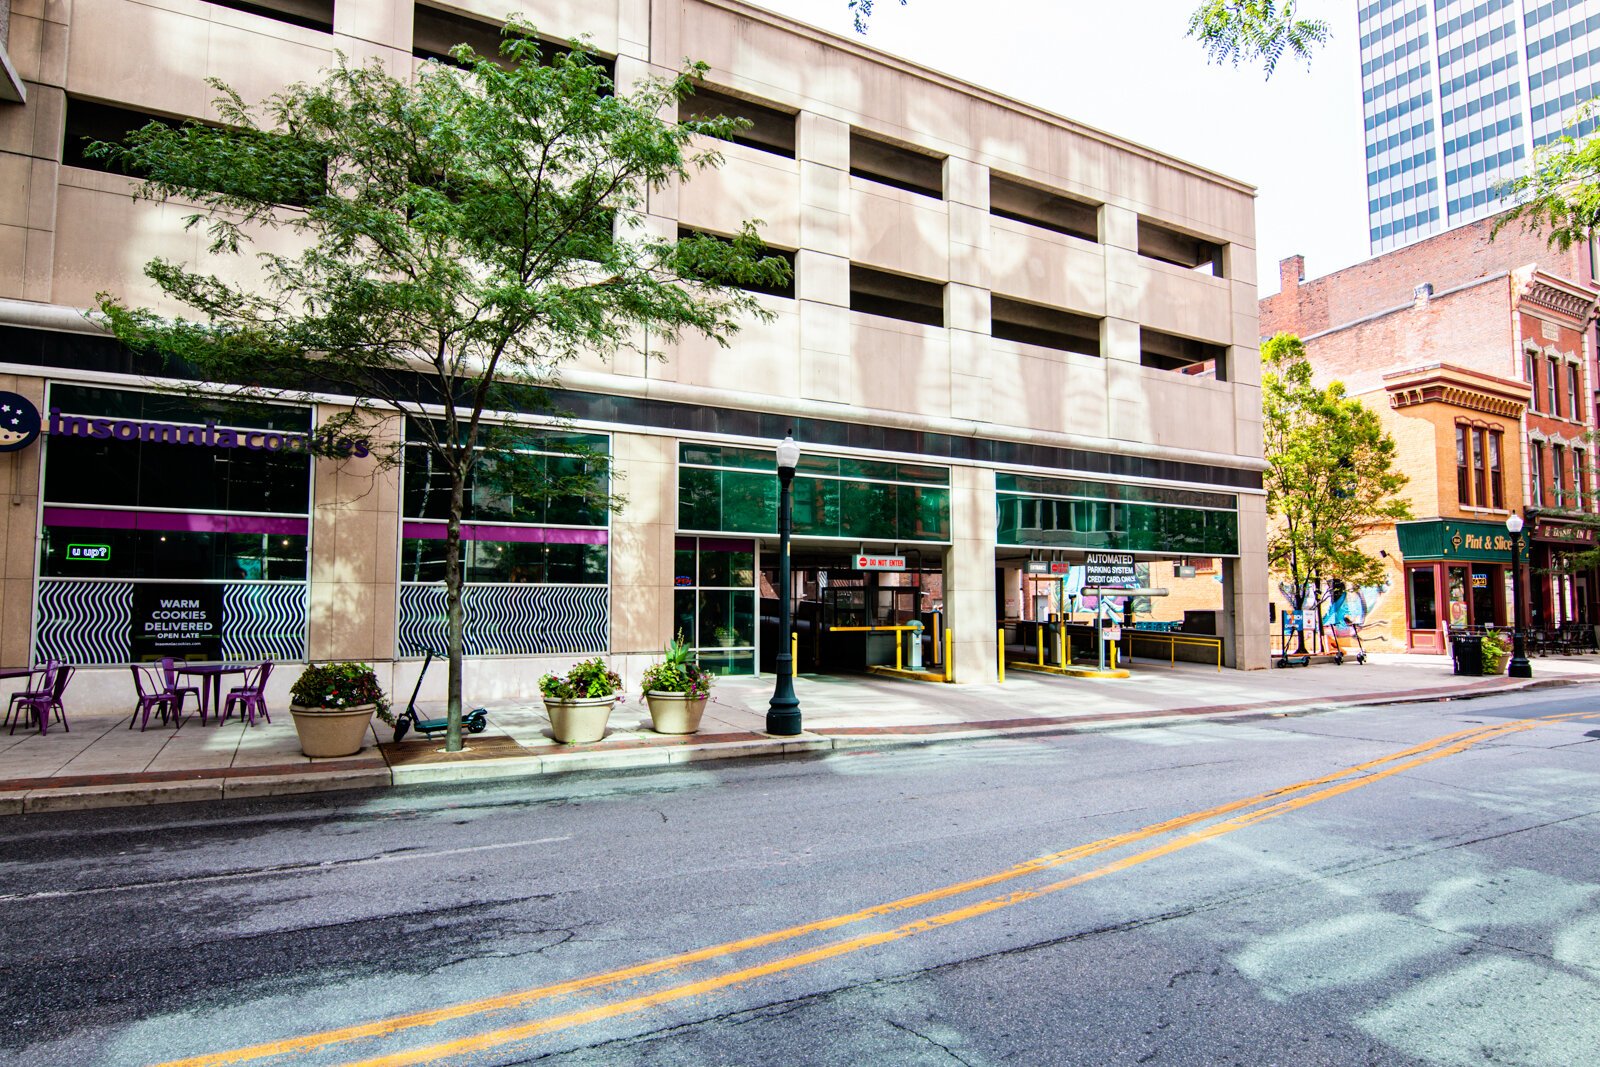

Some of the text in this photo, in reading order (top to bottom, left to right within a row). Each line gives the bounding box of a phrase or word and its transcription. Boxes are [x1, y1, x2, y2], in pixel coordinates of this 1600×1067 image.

[50, 407, 239, 448] insomnia
[1464, 533, 1513, 551] Pint & Slice
[72, 547, 107, 558] u up?
[869, 558, 904, 567] DO NOT ENTER
[1086, 553, 1133, 564] AUTOMATED
[1087, 566, 1134, 574] PARKING SYSTEM
[1087, 575, 1137, 583] CREDIT CARD ONLY
[160, 599, 200, 608] WARM
[152, 610, 207, 620] COOKIES
[144, 622, 213, 631] DELIVERED
